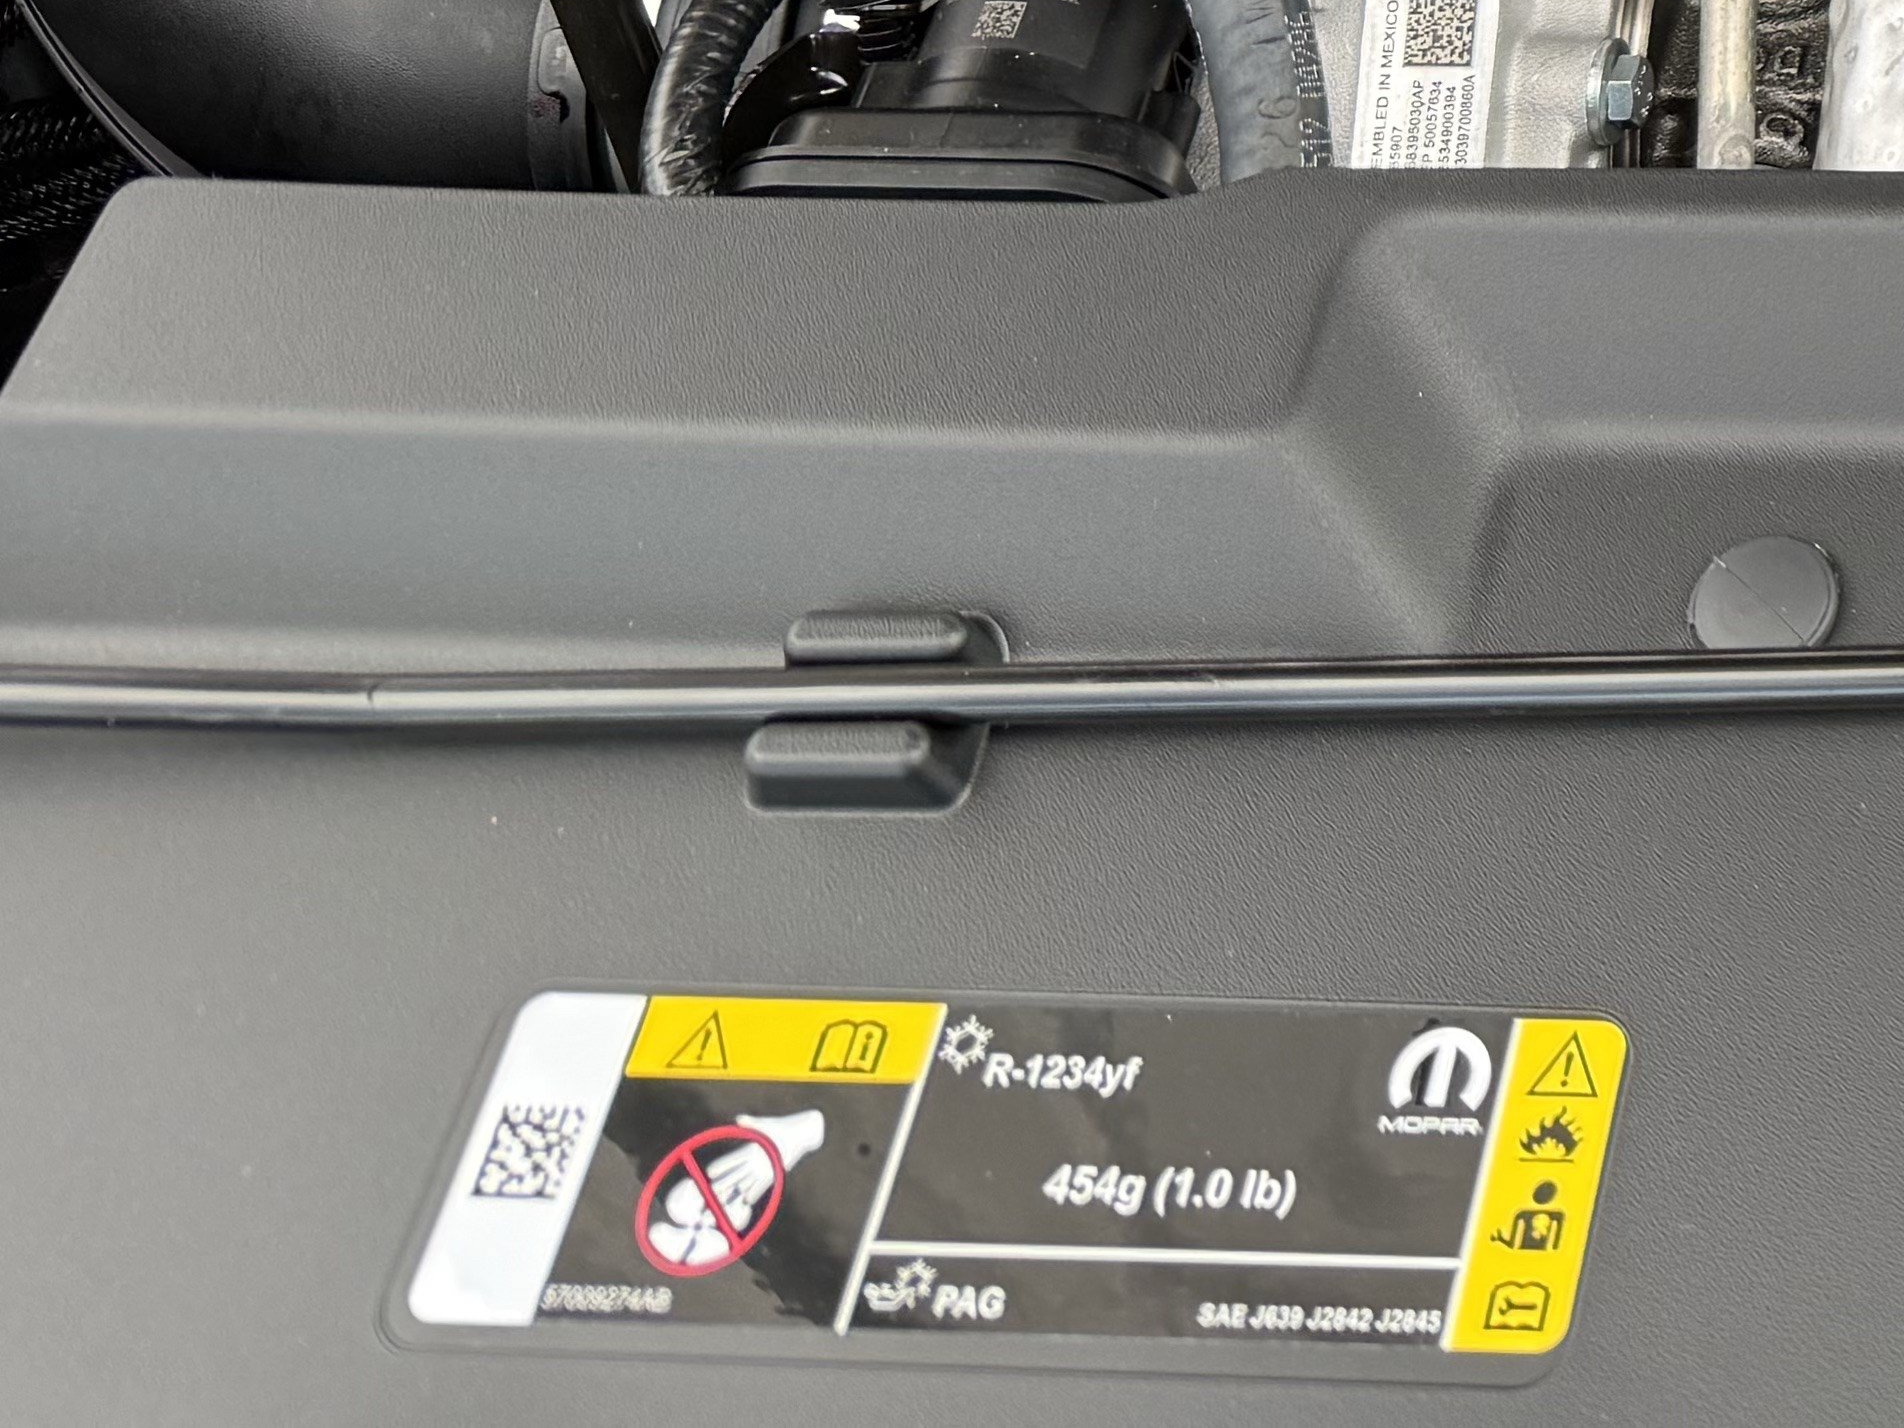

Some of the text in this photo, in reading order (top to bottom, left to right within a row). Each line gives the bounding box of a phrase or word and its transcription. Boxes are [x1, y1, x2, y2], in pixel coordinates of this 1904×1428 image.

[1378, 72, 1392, 90] IN
[982, 1051, 1144, 1099] R-1234yf
[1376, 1114, 1484, 1137] MOPAR
[1041, 1162, 1299, 1220] 454g (1.0 lb)
[930, 1284, 1007, 1320] PAG
[1196, 1302, 1442, 1334] SAE J639 J2842 J2845
